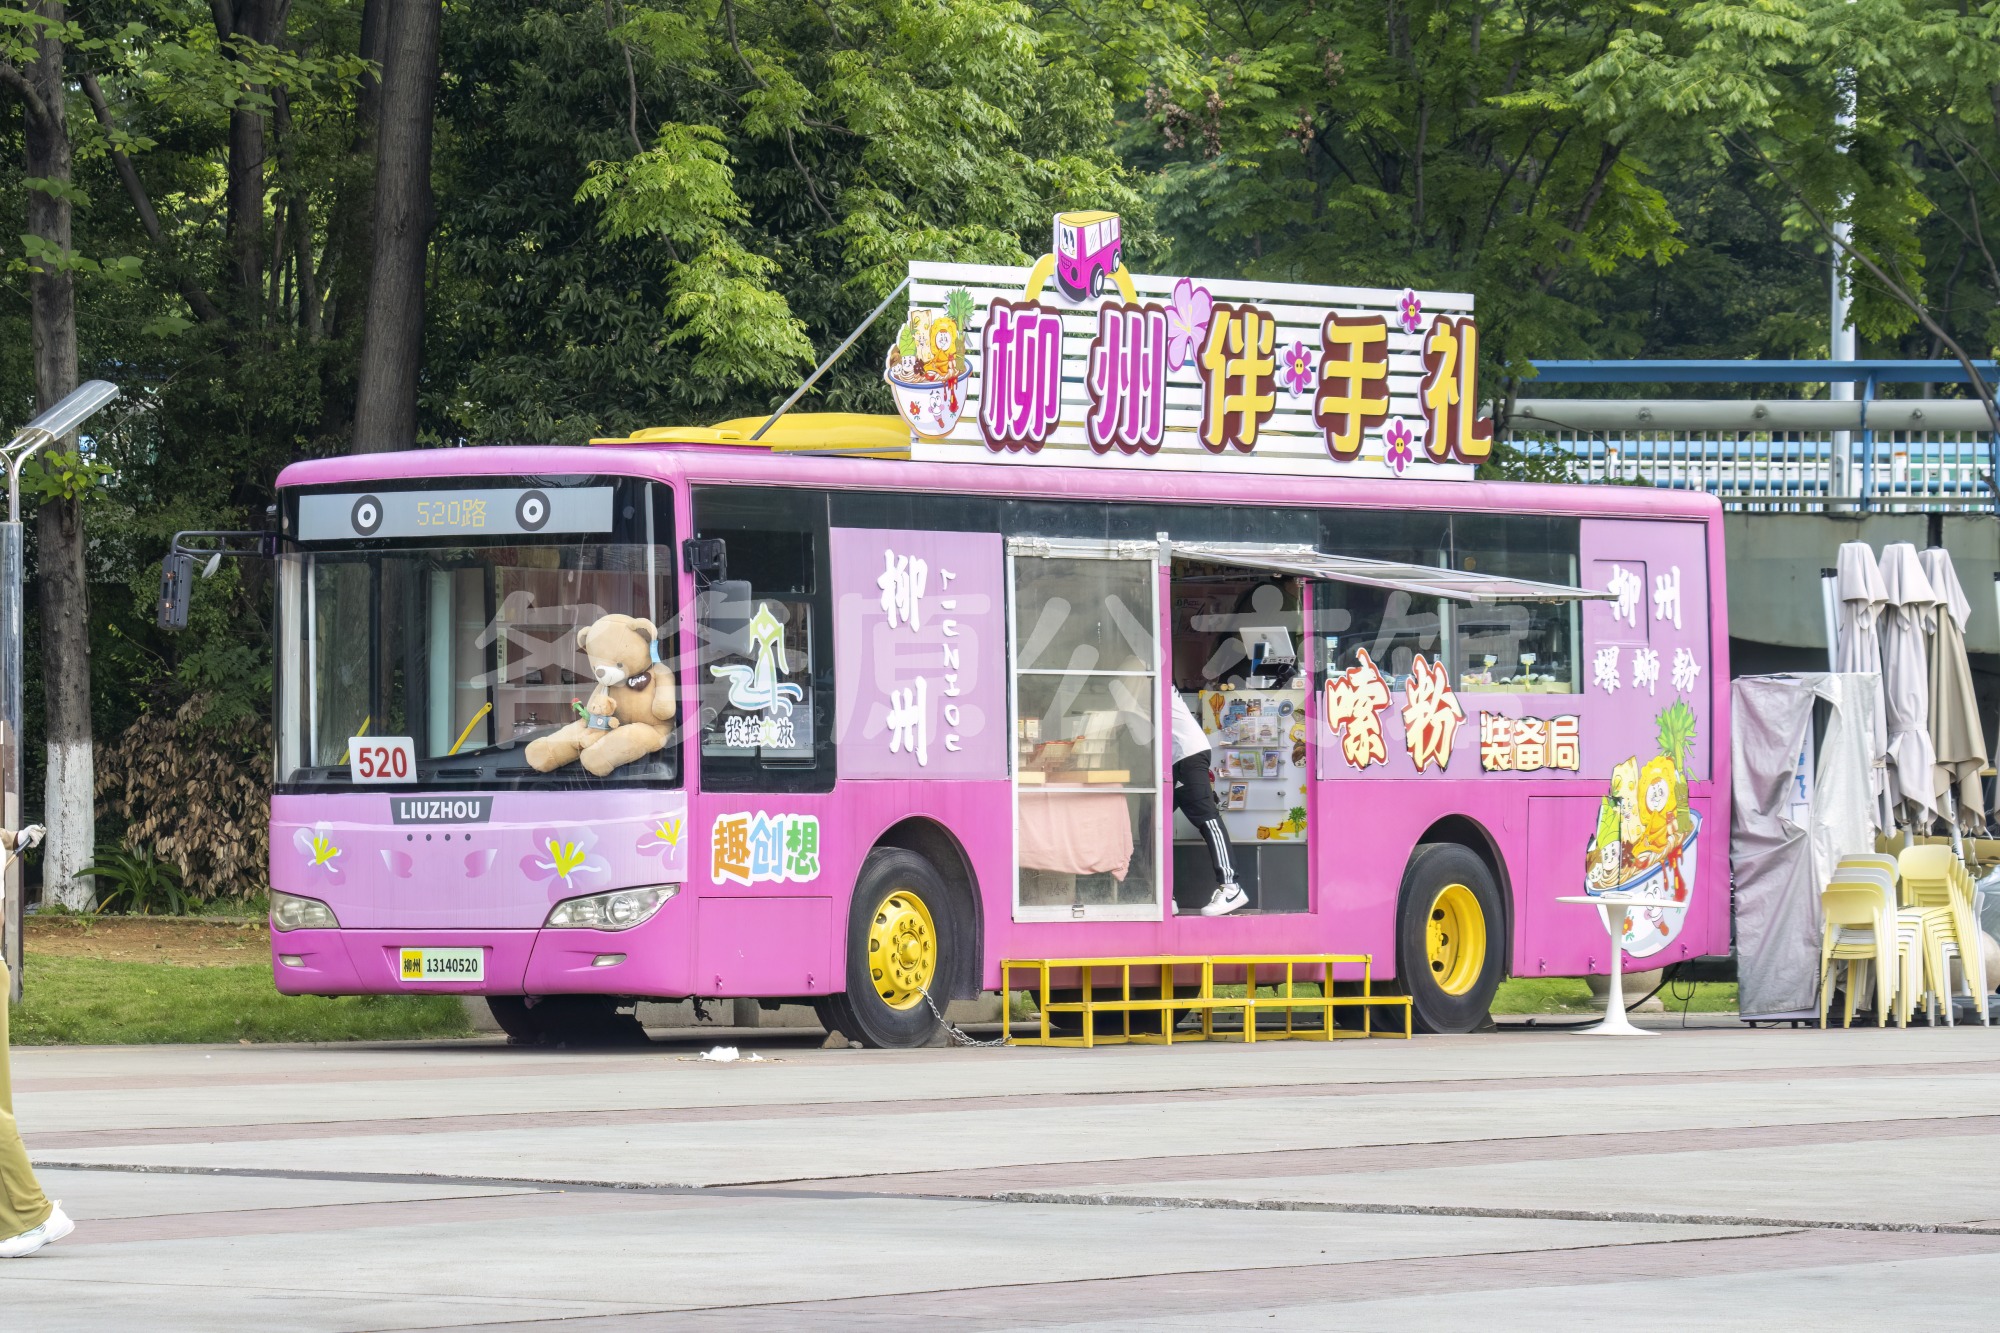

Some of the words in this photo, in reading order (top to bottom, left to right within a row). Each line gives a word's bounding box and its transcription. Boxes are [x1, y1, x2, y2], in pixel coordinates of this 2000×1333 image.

[980, 298, 1491, 464] 柳州伴手礼
[416, 498, 487, 529] 520路
[1606, 563, 1682, 630] 柳州
[876, 548, 929, 767] 柳州
[726, 717, 795, 747] 投控文旅
[1324, 648, 1464, 772] 嗦粉
[1480, 711, 1581, 772] 装备局
[358, 746, 408, 779] 520
[400, 801, 481, 820] LIUZHOU
[711, 813, 821, 885] 趣创想
[404, 958, 421, 973] 柳州
[426, 958, 478, 973] 13140520
